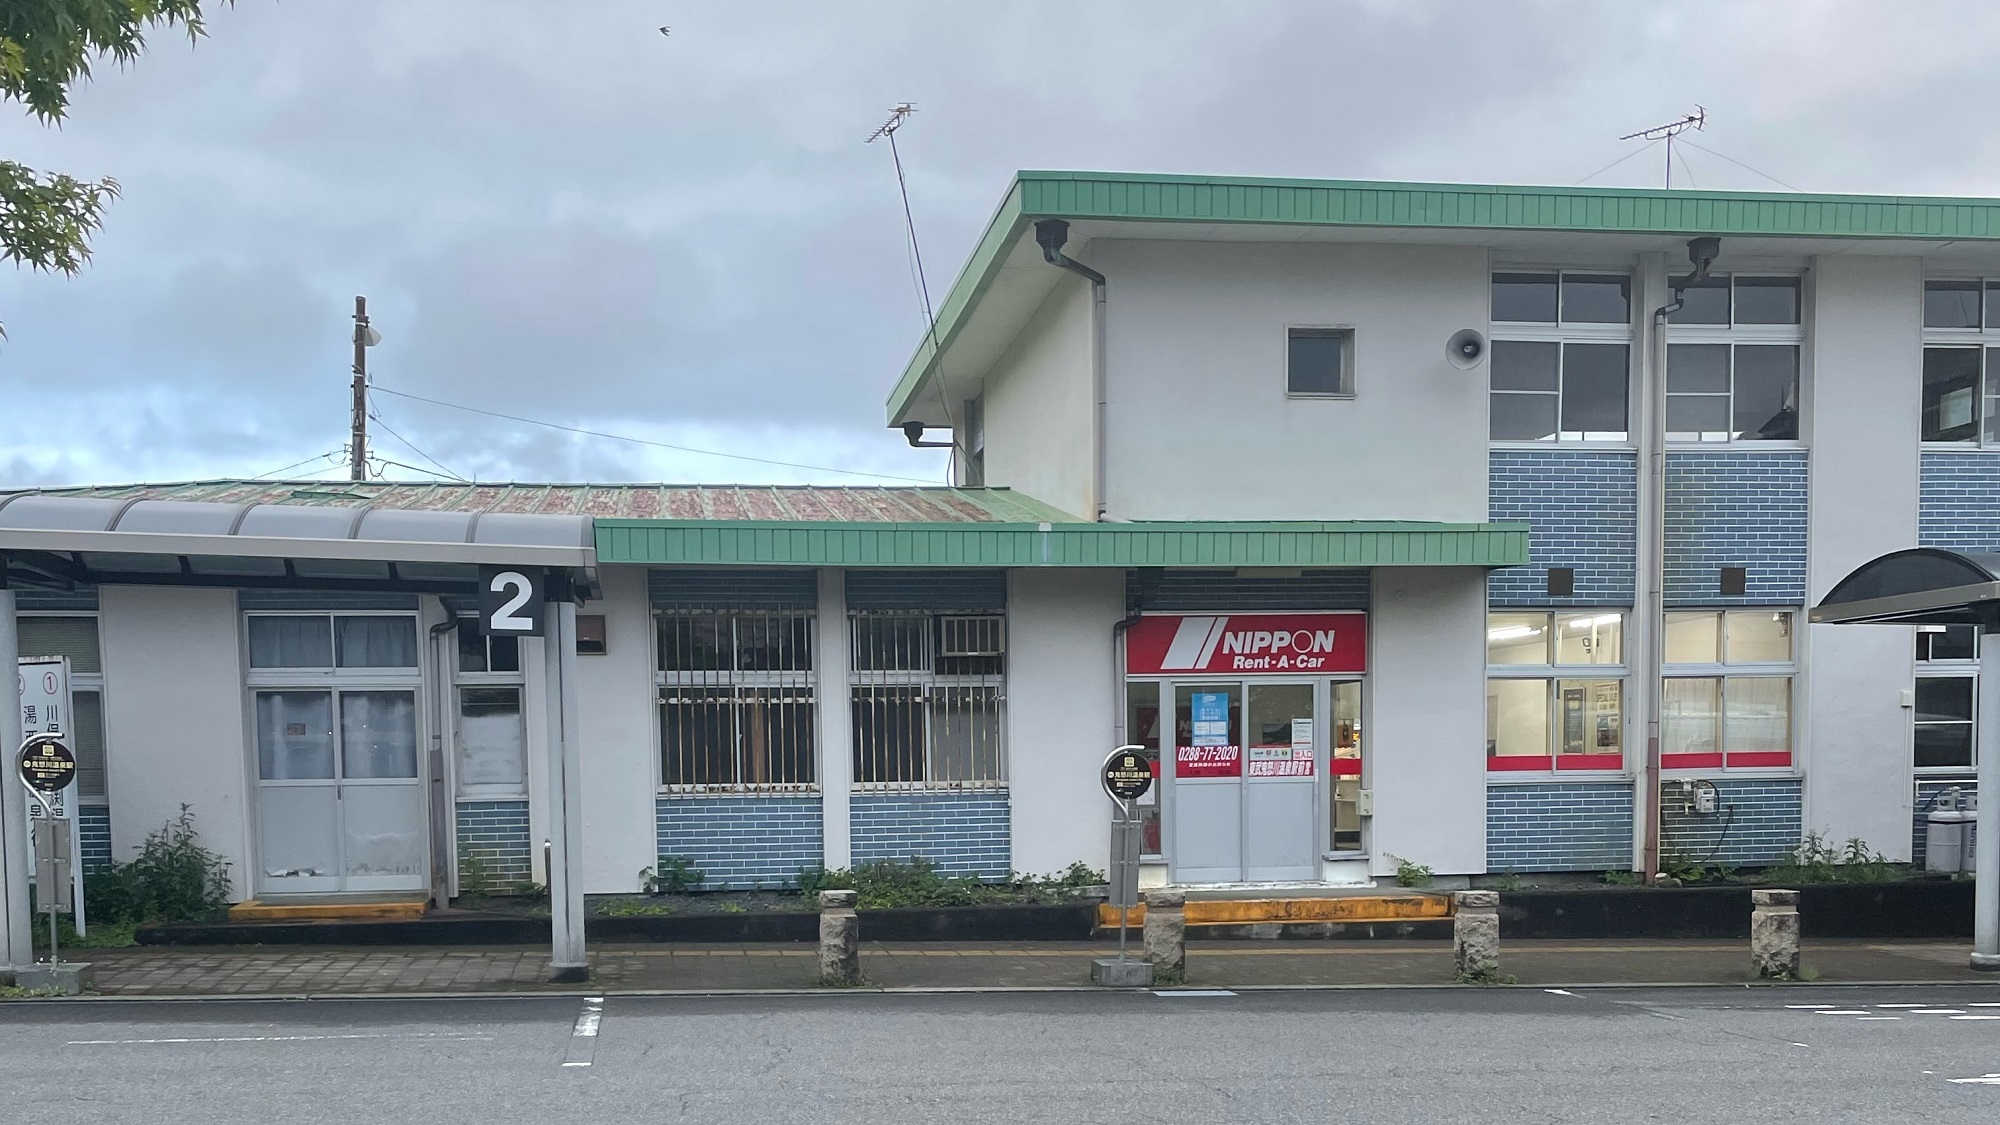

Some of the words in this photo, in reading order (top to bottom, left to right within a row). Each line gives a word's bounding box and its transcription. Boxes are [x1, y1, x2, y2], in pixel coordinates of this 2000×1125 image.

[490, 571, 533, 631] 2
[1222, 630, 1335, 654] NIPPON
[1233, 655, 1325, 669] Rent-A-Car
[1178, 745, 1239, 761] 0288-77-2020
[1294, 750, 1313, 759] 出入口
